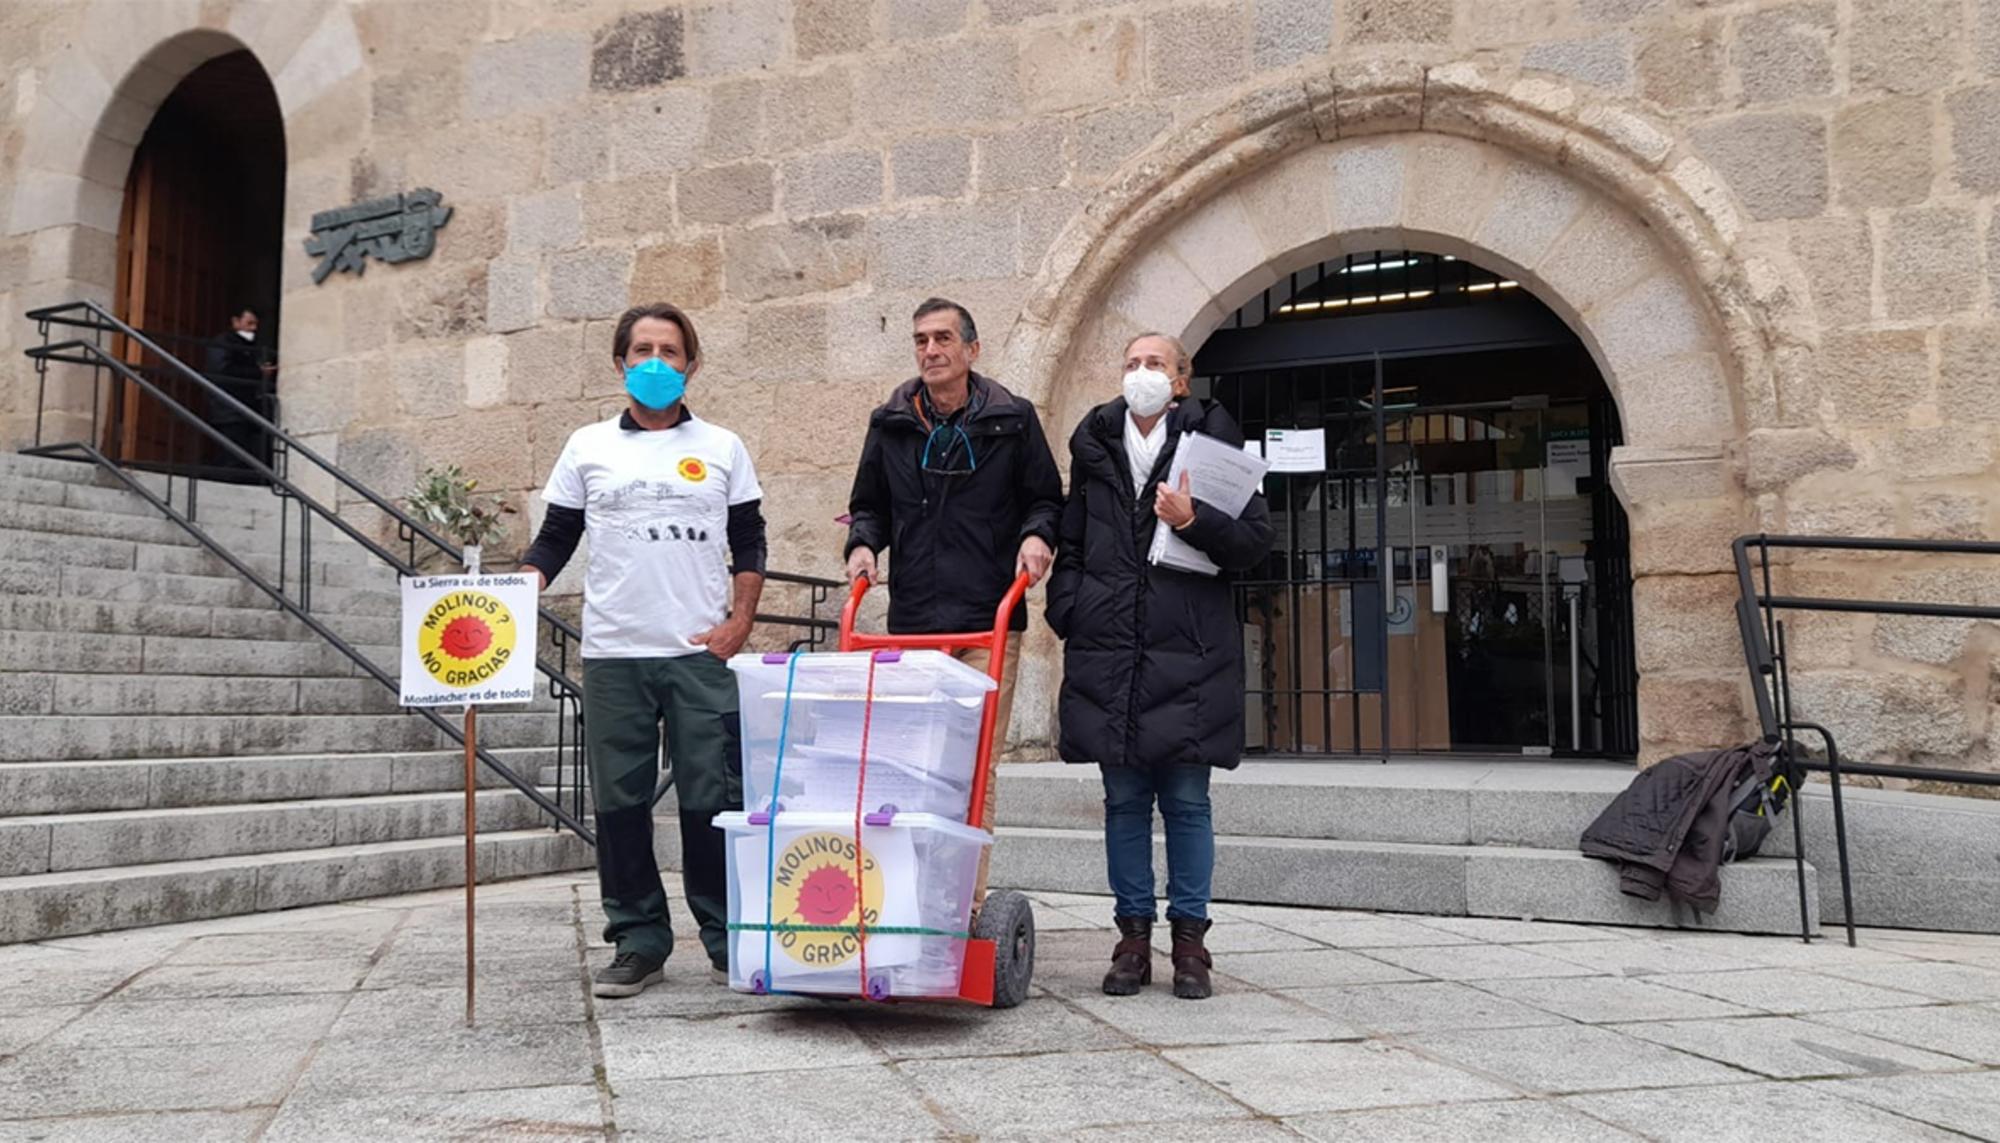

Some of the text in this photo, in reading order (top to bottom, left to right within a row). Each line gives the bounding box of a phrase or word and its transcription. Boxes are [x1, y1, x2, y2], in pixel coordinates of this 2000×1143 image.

[413, 579, 426, 588] La
[428, 577, 460, 588] Sierra
[477, 577, 491, 586] de
[424, 593, 510, 630] MOLINOS ?
[422, 646, 511, 686] NO GRACIAS
[469, 692, 481, 700] es
[483, 688, 498, 699] de
[500, 687, 530, 698] todos
[776, 836, 857, 887] MOLINOS
[802, 907, 879, 963] GRACIS
